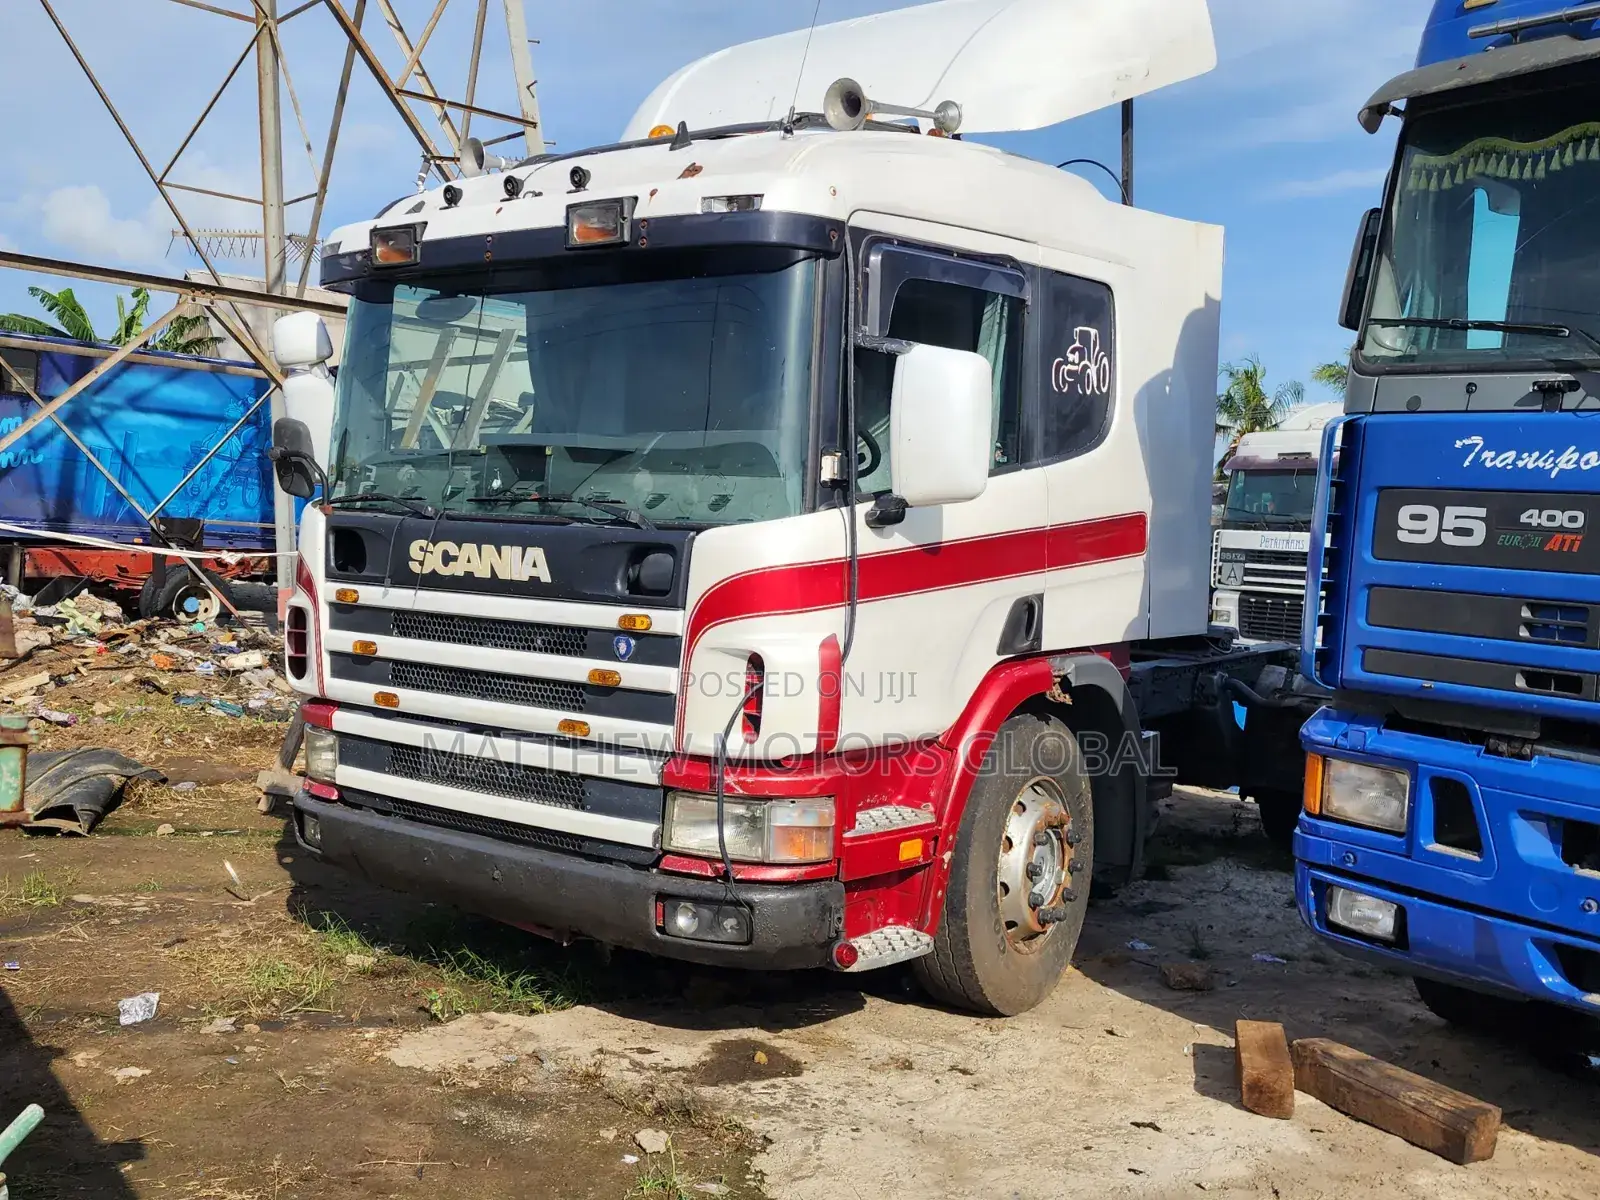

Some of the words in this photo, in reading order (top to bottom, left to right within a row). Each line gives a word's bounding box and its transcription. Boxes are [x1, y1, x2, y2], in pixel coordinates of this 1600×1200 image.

[1397, 504, 1487, 547] 95
[1520, 508, 1585, 529] 400
[408, 539, 552, 583] SCANIA
